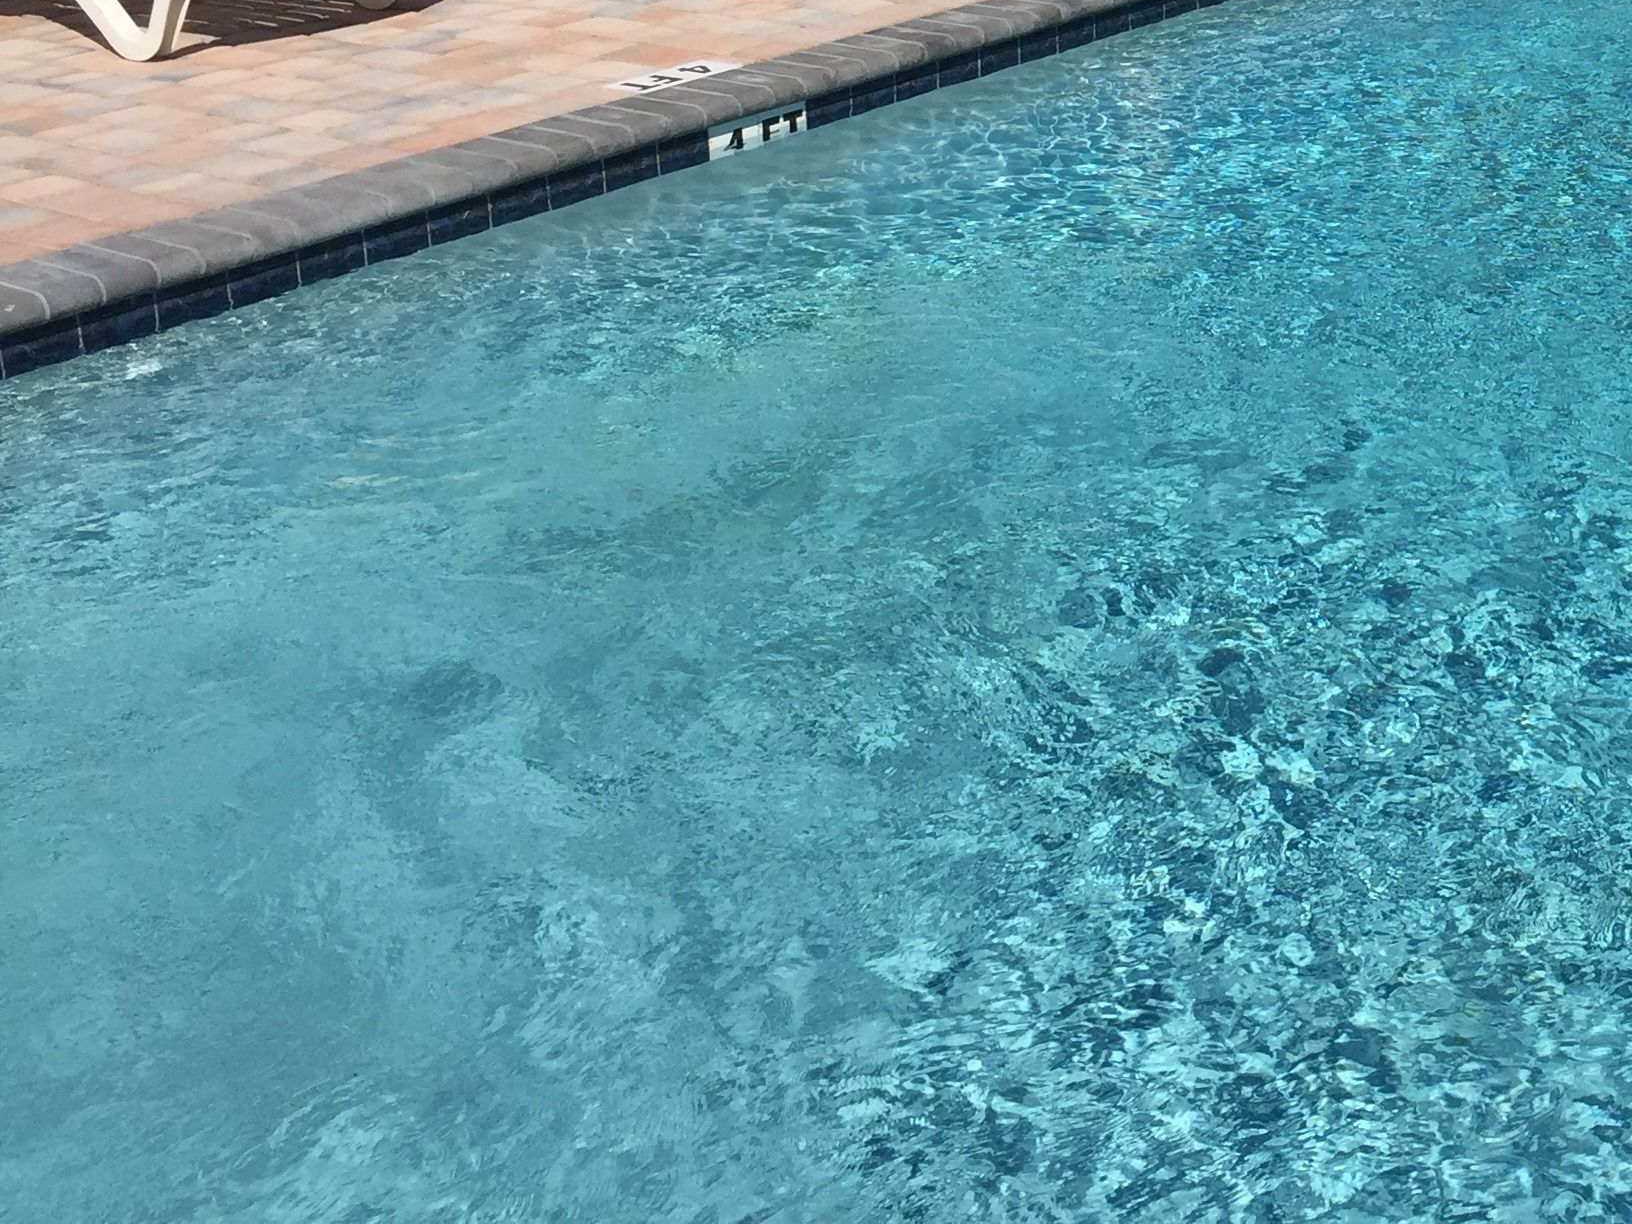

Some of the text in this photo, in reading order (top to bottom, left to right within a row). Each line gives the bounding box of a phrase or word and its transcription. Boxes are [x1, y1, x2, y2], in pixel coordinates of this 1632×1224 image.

[619, 65, 711, 91] 4 FT
[761, 108, 804, 143] FT
